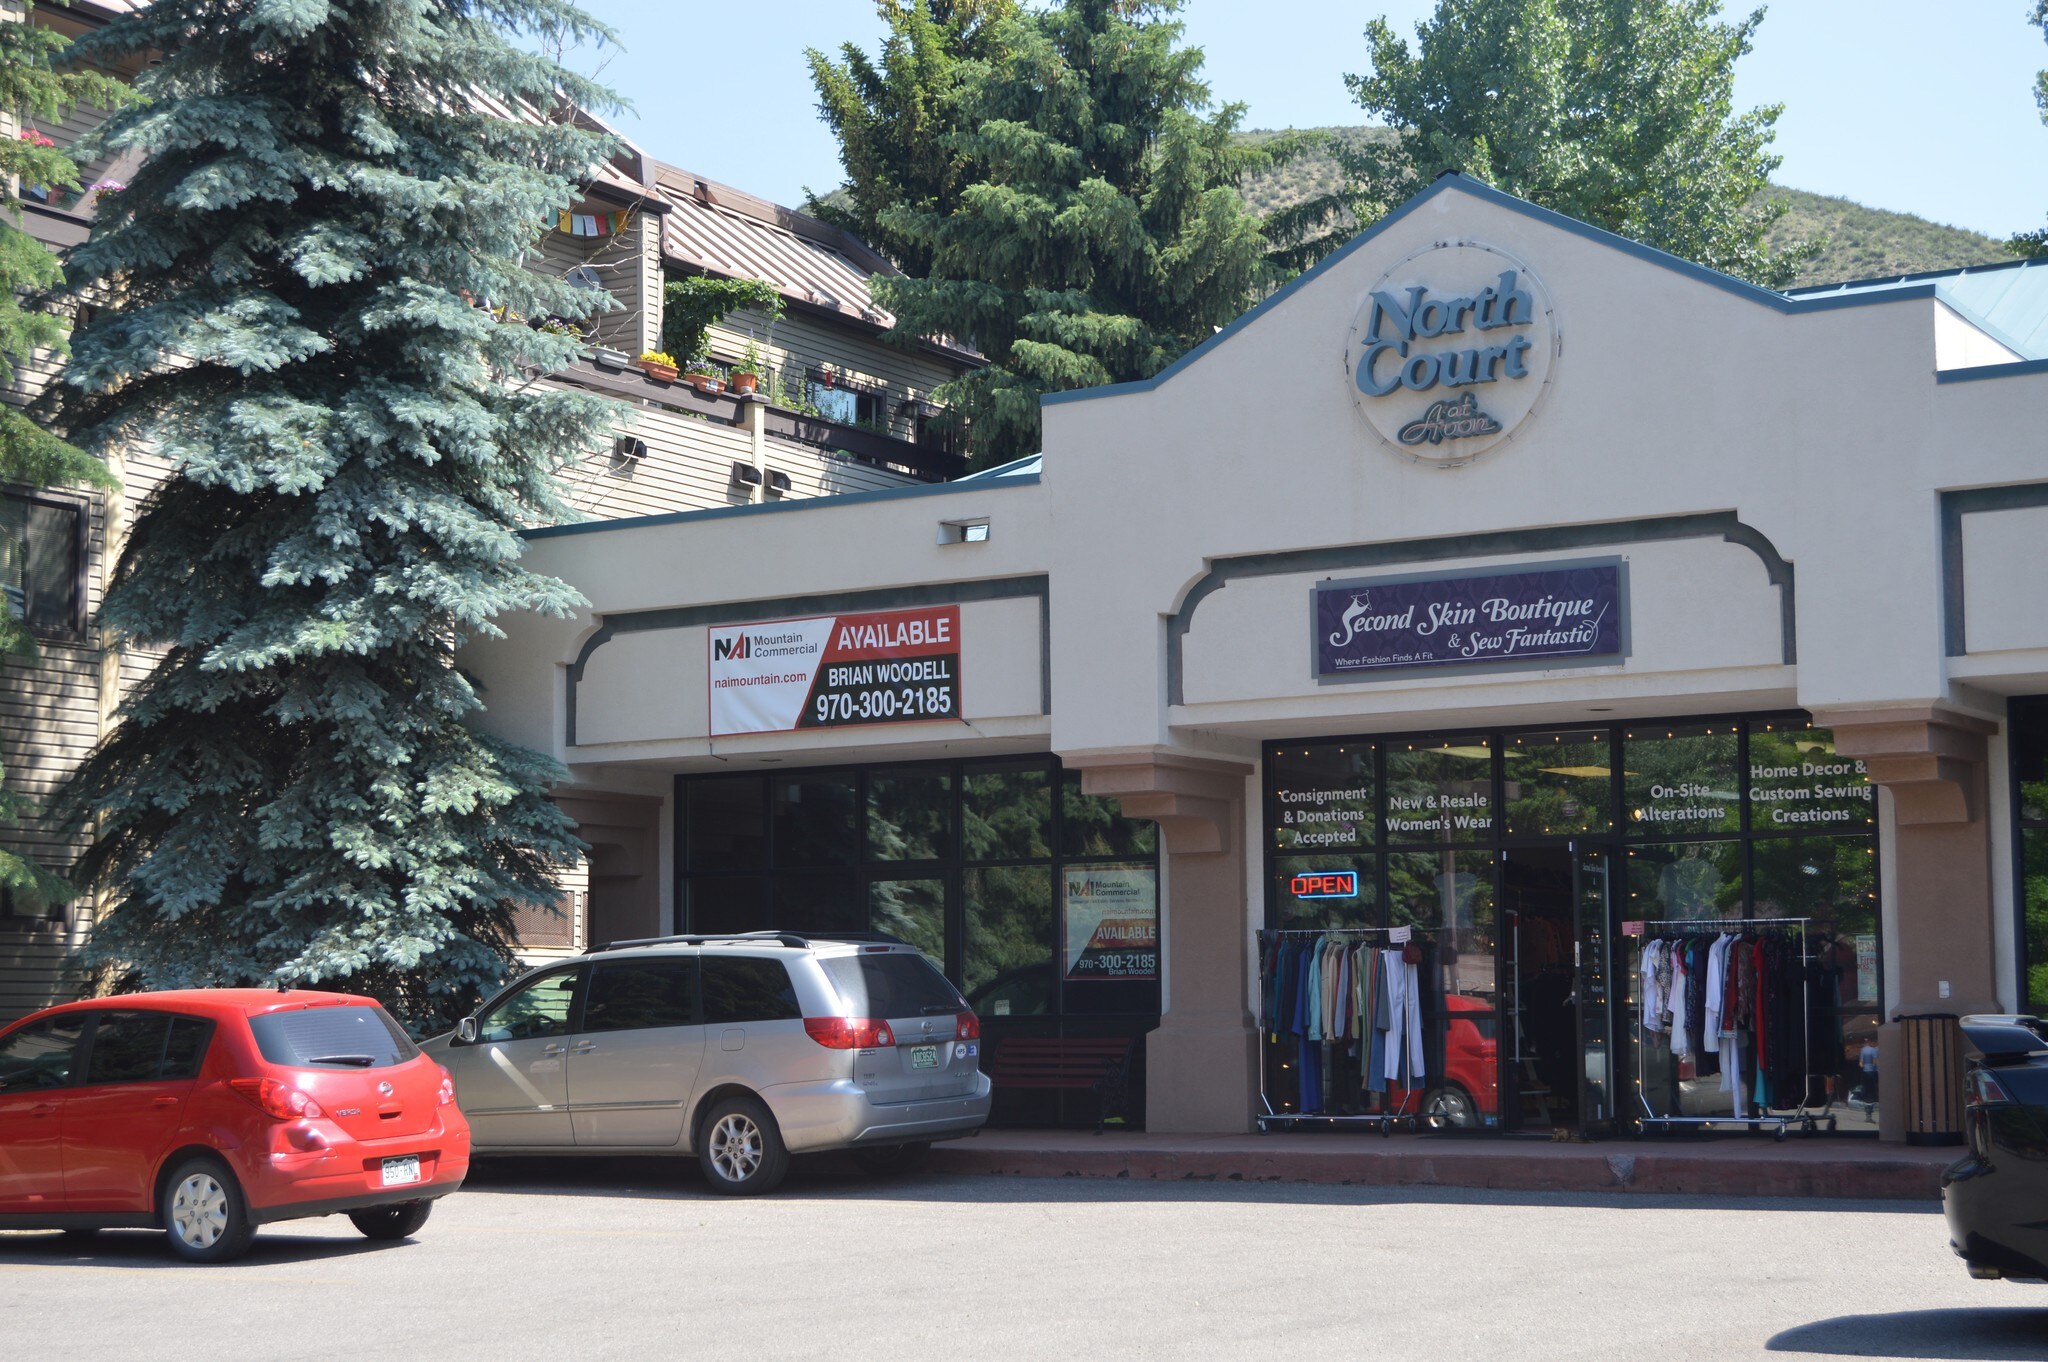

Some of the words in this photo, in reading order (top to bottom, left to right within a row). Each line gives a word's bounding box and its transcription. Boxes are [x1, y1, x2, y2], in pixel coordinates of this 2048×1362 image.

[1361, 269, 1534, 346] North
[1356, 335, 1532, 397] Court
[1447, 394, 1473, 417] at
[1330, 596, 1414, 647] Second
[1417, 602, 1476, 636] Skin
[1482, 595, 1594, 626] Boutique
[838, 618, 950, 650] AVAILABLE
[1448, 633, 1460, 648] &
[1462, 632, 1502, 657] Sew
[1504, 625, 1592, 654] Fantastic
[714, 631, 750, 661] NAI
[754, 633, 802, 646] Mountain
[754, 643, 818, 658] Commercial
[1335, 658, 1360, 666] Where
[1362, 656, 1390, 664] Fashion
[1393, 654, 1413, 662] Finds
[1423, 652, 1433, 660] Fit
[714, 673, 806, 688] naimountain.com
[828, 666, 872, 687] BRIAN
[877, 660, 950, 684] WOODELL
[816, 687, 951, 721] 970-300-2185
[1751, 765, 1798, 779] Home
[1803, 763, 1850, 777] Decor
[1855, 760, 1867, 774] &
[1280, 787, 1366, 806] Consignment
[1650, 783, 1710, 799] On-Site
[1750, 786, 1810, 801] Custom
[1814, 783, 1872, 800] Sewing
[1390, 796, 1422, 810] New
[1426, 796, 1437, 809] &
[1441, 793, 1487, 808] Resale
[1284, 811, 1294, 824] &
[1297, 808, 1364, 823] Donations
[1640, 805, 1725, 822] Alterations
[1772, 808, 1849, 823] Creations
[1386, 816, 1450, 832] Women's
[1454, 816, 1492, 829] Wear
[1294, 828, 1356, 846] Accepted
[1069, 879, 1094, 896] NAI
[1096, 888, 1140, 896] Commercial
[1290, 876, 1352, 895] OPEN
[1096, 926, 1155, 939] AVAILABLE
